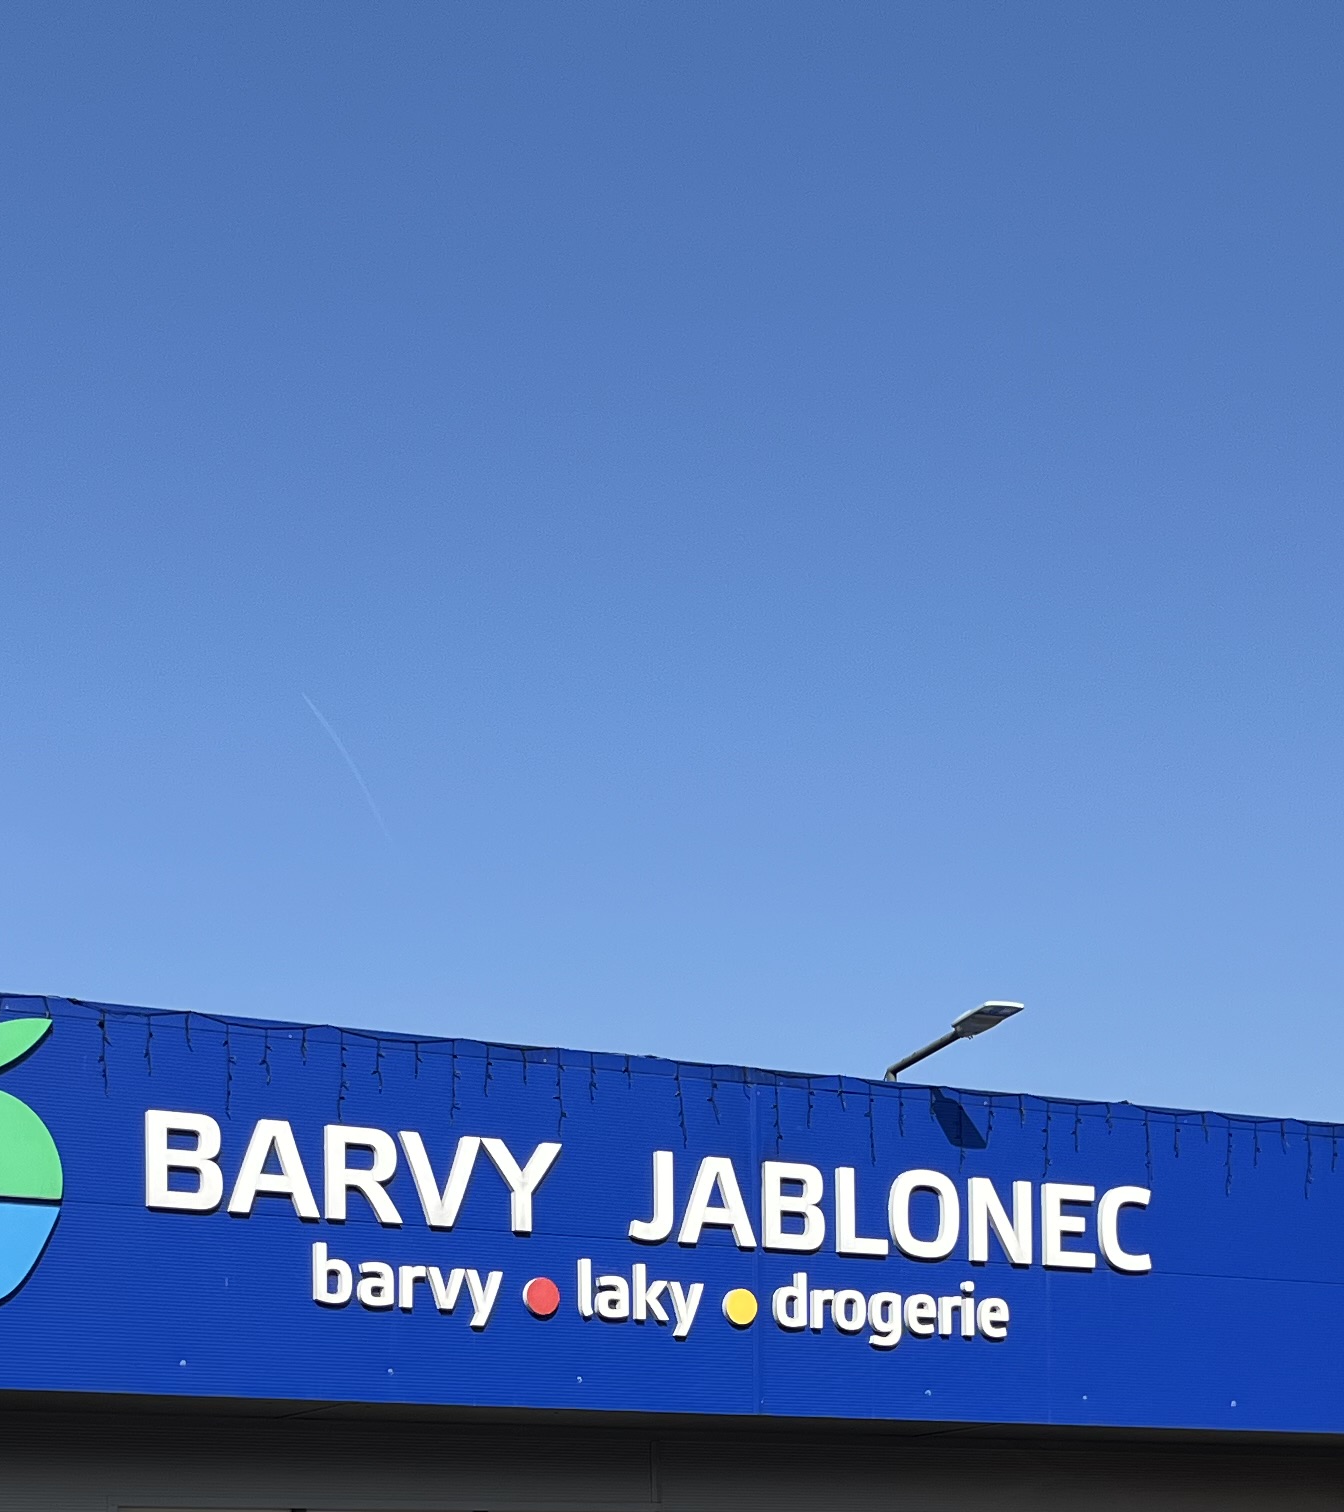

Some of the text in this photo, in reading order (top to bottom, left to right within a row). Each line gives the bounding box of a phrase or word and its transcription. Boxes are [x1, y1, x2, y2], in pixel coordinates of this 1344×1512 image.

[145, 1109, 1153, 1273] BARVY JABLONEC
[312, 1241, 1010, 1349] barvy laky drogerie
